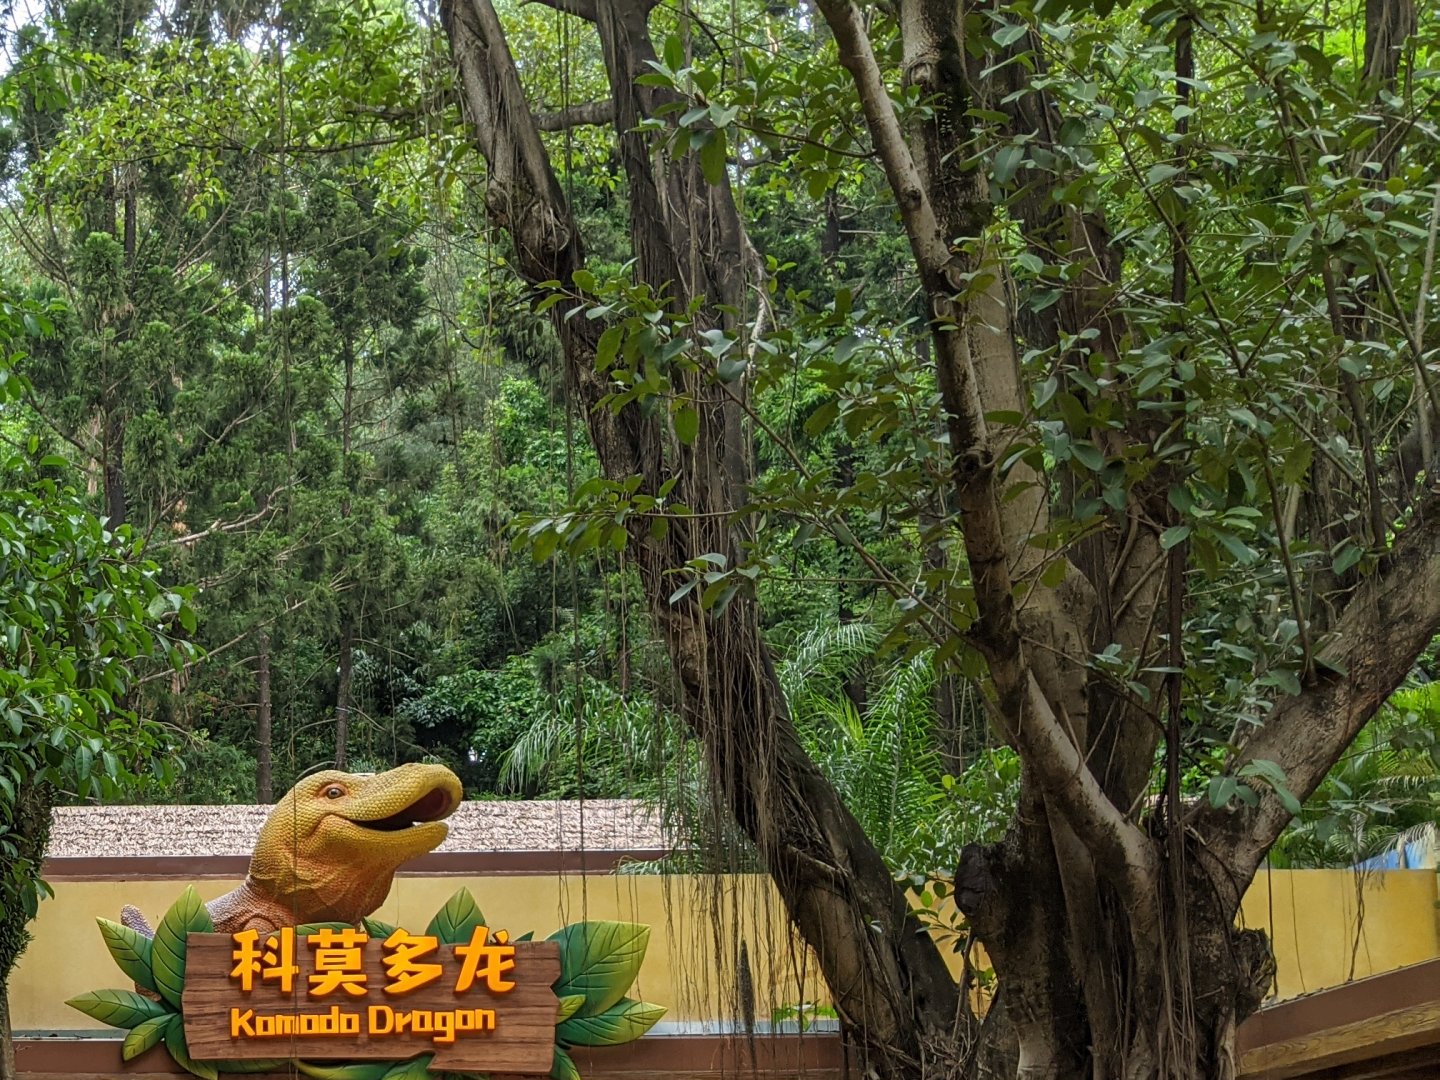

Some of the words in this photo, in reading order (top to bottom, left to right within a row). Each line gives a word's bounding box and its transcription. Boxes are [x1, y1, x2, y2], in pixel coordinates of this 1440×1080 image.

[230, 926, 516, 995] 科莫多龙
[231, 1005, 360, 1037] Komodo
[368, 1005, 496, 1042] Dragon
